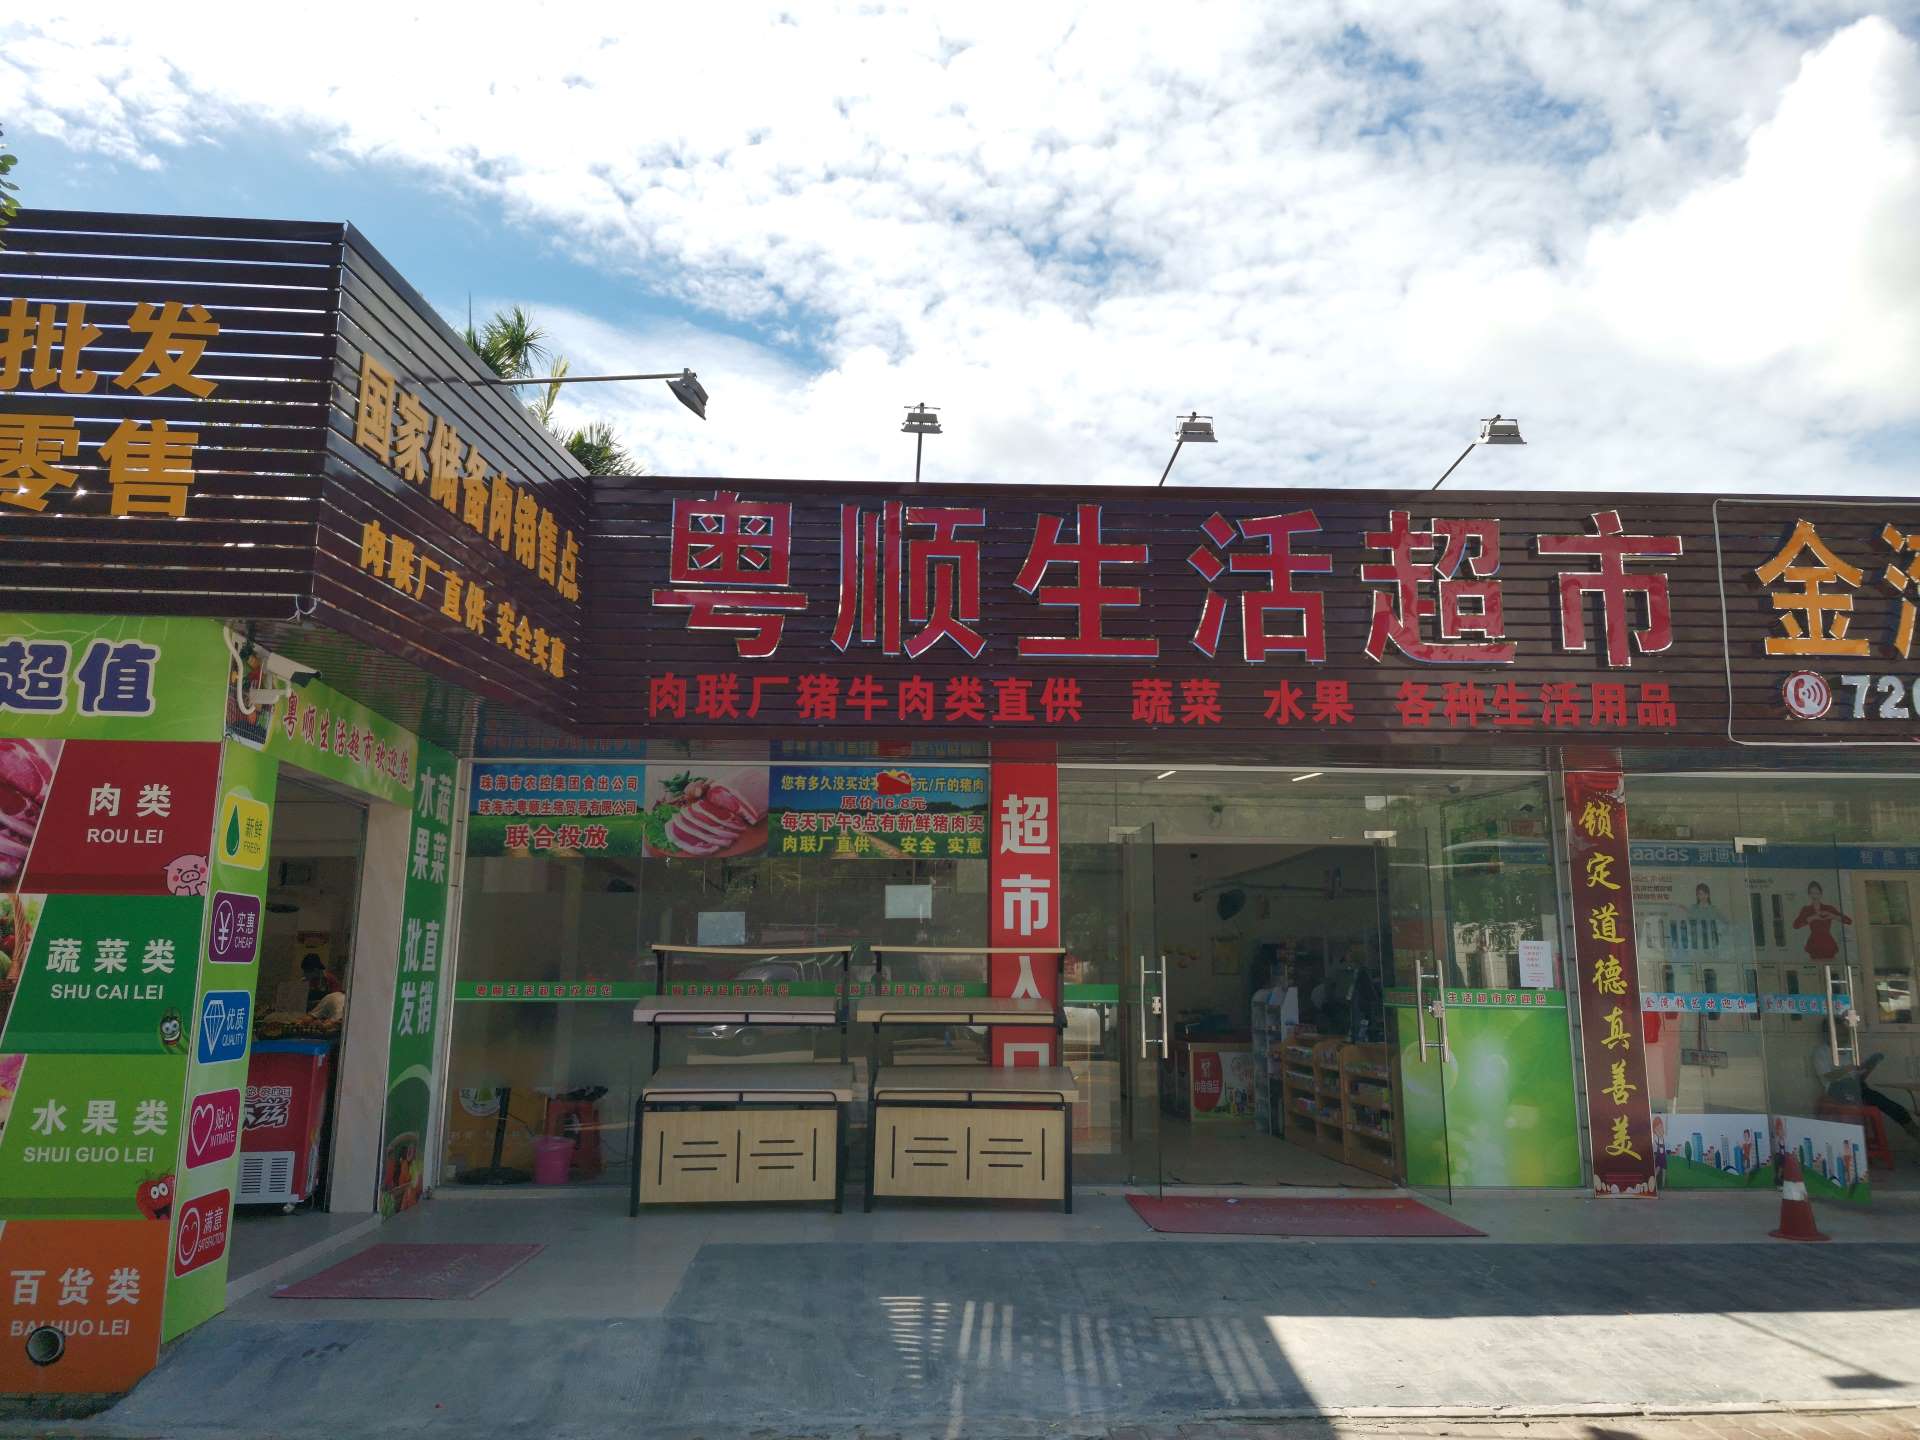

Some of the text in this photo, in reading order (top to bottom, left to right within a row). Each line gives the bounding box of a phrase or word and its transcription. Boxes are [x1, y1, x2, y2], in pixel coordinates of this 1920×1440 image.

[0, 297, 220, 398] 批发
[0, 413, 199, 517] 零售
[355, 351, 581, 602] 国家储备肉销售点
[651, 489, 1684, 669] 粤顺生活超市
[360, 519, 566, 679] 肉联厂直供 安全实惠
[0, 637, 161, 716] 超值
[648, 673, 1679, 727] 肉联厂猪牛肉类直供 蔬菜 水果 各种生活用品
[781, 775, 985, 794] 您有多久没买过元/斤的猪肉
[88, 783, 172, 819] 肉类
[781, 812, 985, 833] 每天下午3点有新鲜猪肉买
[87, 829, 164, 844] ROU LEI
[504, 823, 609, 850] 联合投放
[782, 835, 984, 855] 肉联厂直供 安全 实惠
[1628, 845, 1690, 861] aadas
[236, 911, 257, 934] 实惠
[46, 938, 176, 974] 蔬菜类
[234, 936, 254, 950] CHEAP
[50, 984, 164, 1000] SHU CAI LEI
[1578, 800, 1643, 1163] 锁定道德真善美
[226, 1008, 246, 1031] 优质
[31, 1099, 168, 1136] 水果类
[214, 1107, 235, 1130] 贴心
[209, 1130, 237, 1147] INTIMATE
[23, 1147, 155, 1163] SHUI GUO LEI
[203, 1206, 225, 1233] 满意
[10, 1268, 141, 1306] 百货类
[97, 1320, 130, 1335] LEI
